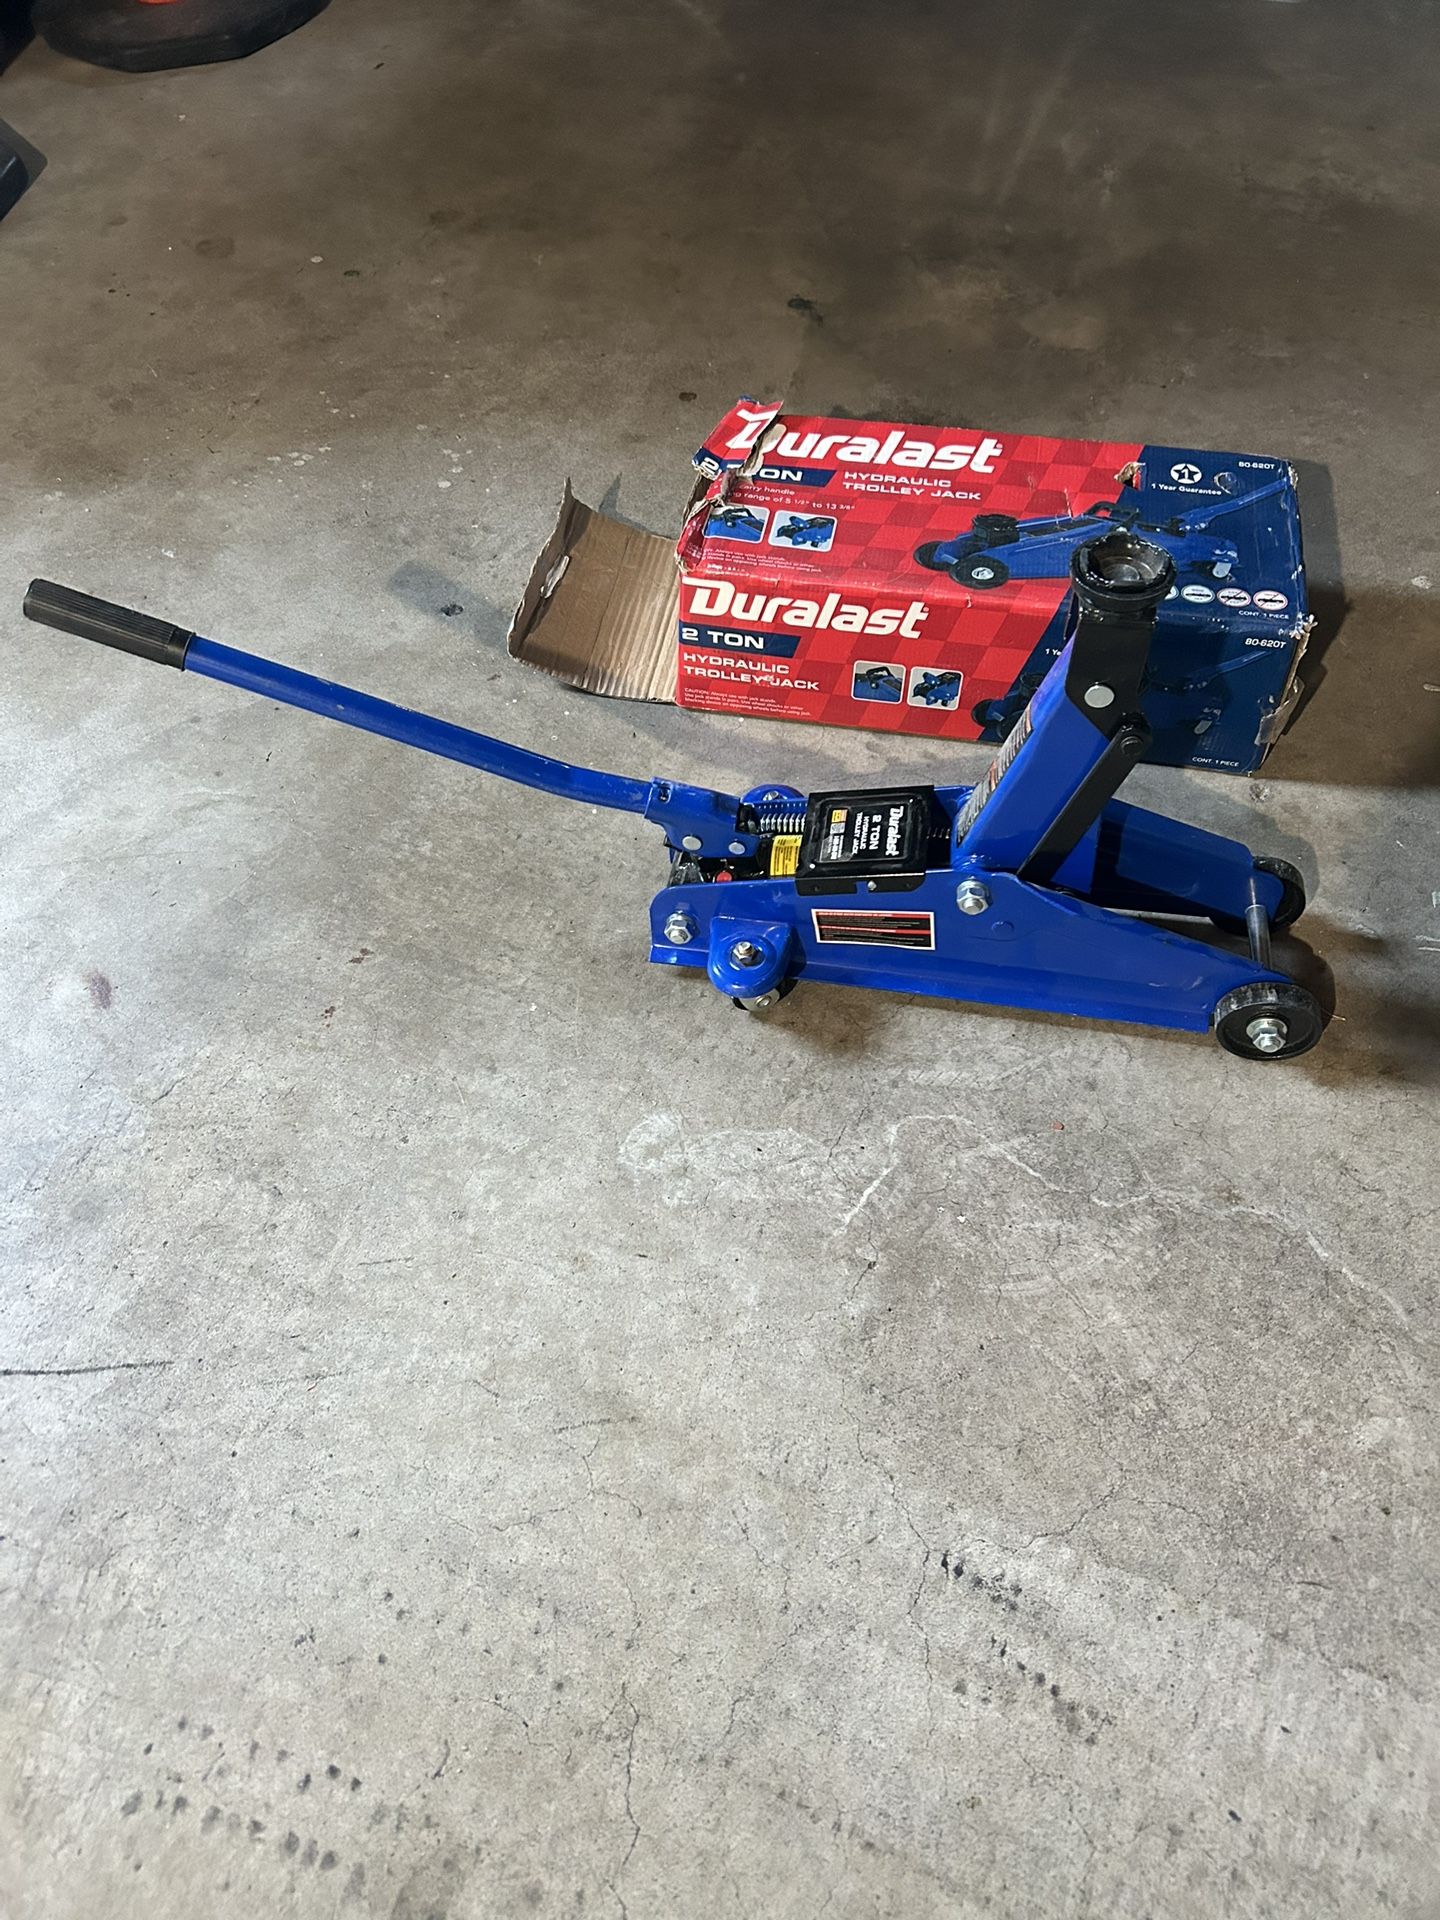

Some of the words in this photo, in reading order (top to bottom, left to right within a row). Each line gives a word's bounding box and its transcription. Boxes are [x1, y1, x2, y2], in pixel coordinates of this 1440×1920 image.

[725, 408, 1002, 474] Duralast
[700, 457, 719, 475] 2
[1238, 461, 1275, 470] 80-620T
[844, 470, 952, 488] HYDRAULIC
[744, 492, 771, 501] range
[764, 486, 795, 496] handle
[842, 482, 925, 497] TROLLEY
[931, 491, 982, 501] JACK
[1159, 483, 1176, 491] Year
[1178, 485, 1222, 496] Guarantee
[682, 576, 929, 639] Duralast
[681, 627, 698, 641] 2
[707, 630, 764, 650] TON
[1244, 637, 1286, 649] 80-620T
[684, 652, 790, 674] HYDRAULIC
[684, 665, 765, 685] TROLLEY
[771, 675, 820, 691] JACK
[869, 825, 881, 850] TON
[886, 805, 904, 856] Duralast
